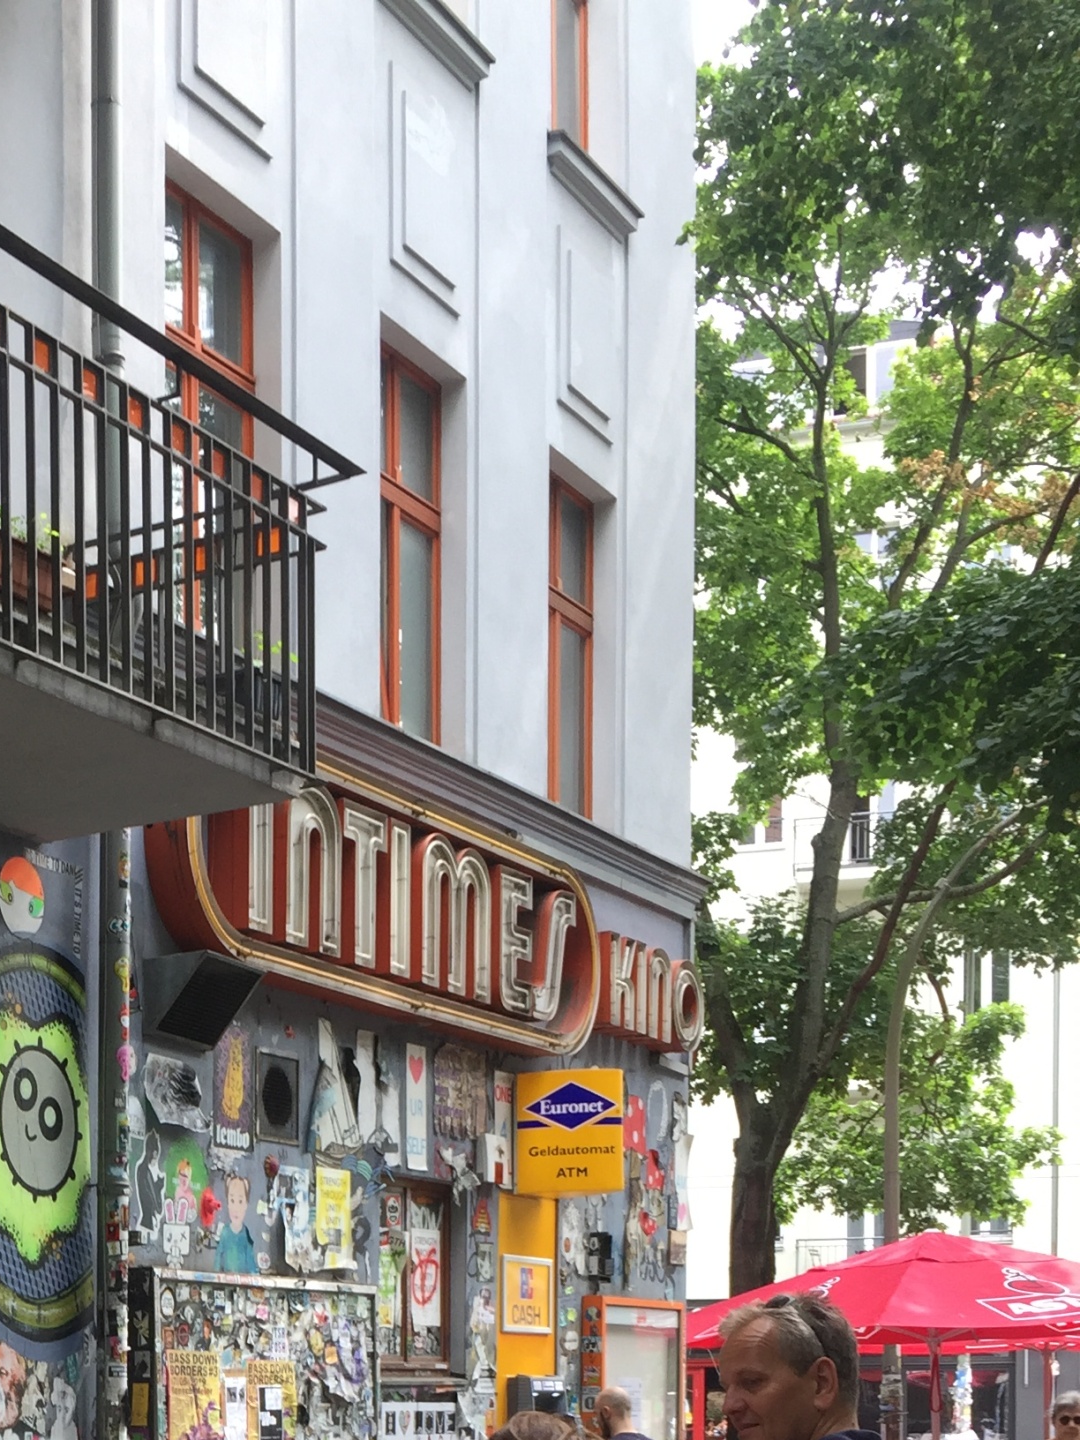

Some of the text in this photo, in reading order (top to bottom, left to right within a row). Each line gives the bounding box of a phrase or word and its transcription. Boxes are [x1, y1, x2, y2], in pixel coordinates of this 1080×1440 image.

[248, 787, 577, 1021] INTIMES
[610, 935, 704, 1054] KINO
[539, 1099, 604, 1116] Euronet
[407, 1135, 426, 1156] SELF
[528, 1144, 616, 1157] Geldautomat
[556, 1166, 588, 1179] ATM
[511, 1304, 542, 1326] CASH
[169, 1353, 218, 1366] BASS DOWN
[170, 1365, 218, 1378] BORDERS #3
[248, 1363, 294, 1375] BASS DOWN
[248, 1374, 284, 1386] BORDERS
